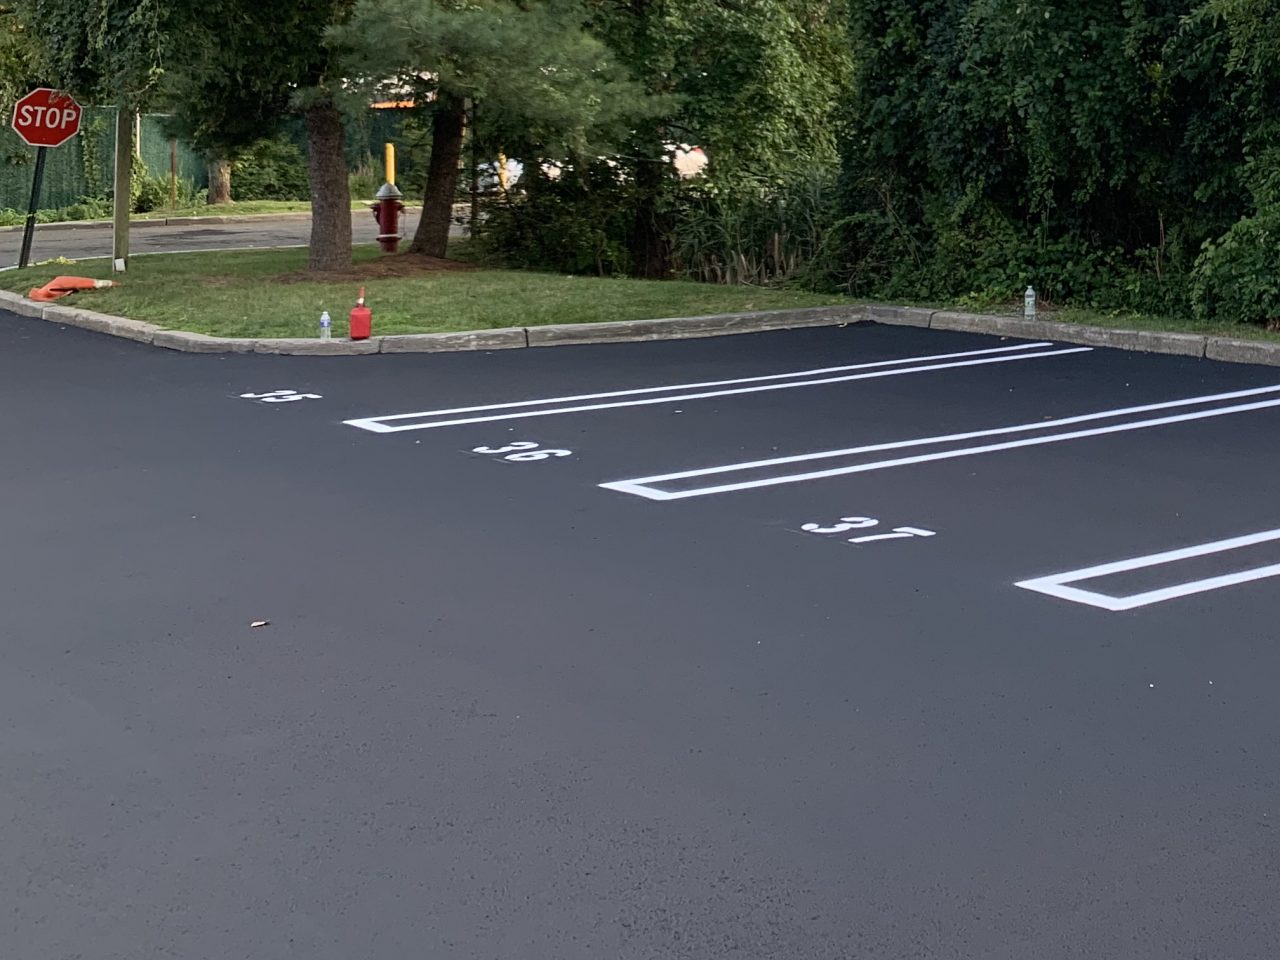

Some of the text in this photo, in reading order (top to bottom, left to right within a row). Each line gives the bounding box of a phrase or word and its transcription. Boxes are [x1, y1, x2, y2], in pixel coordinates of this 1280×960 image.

[18, 105, 76, 129] STOP
[240, 390, 323, 403] 35
[472, 441, 572, 461] 36
[801, 516, 936, 543] 37
